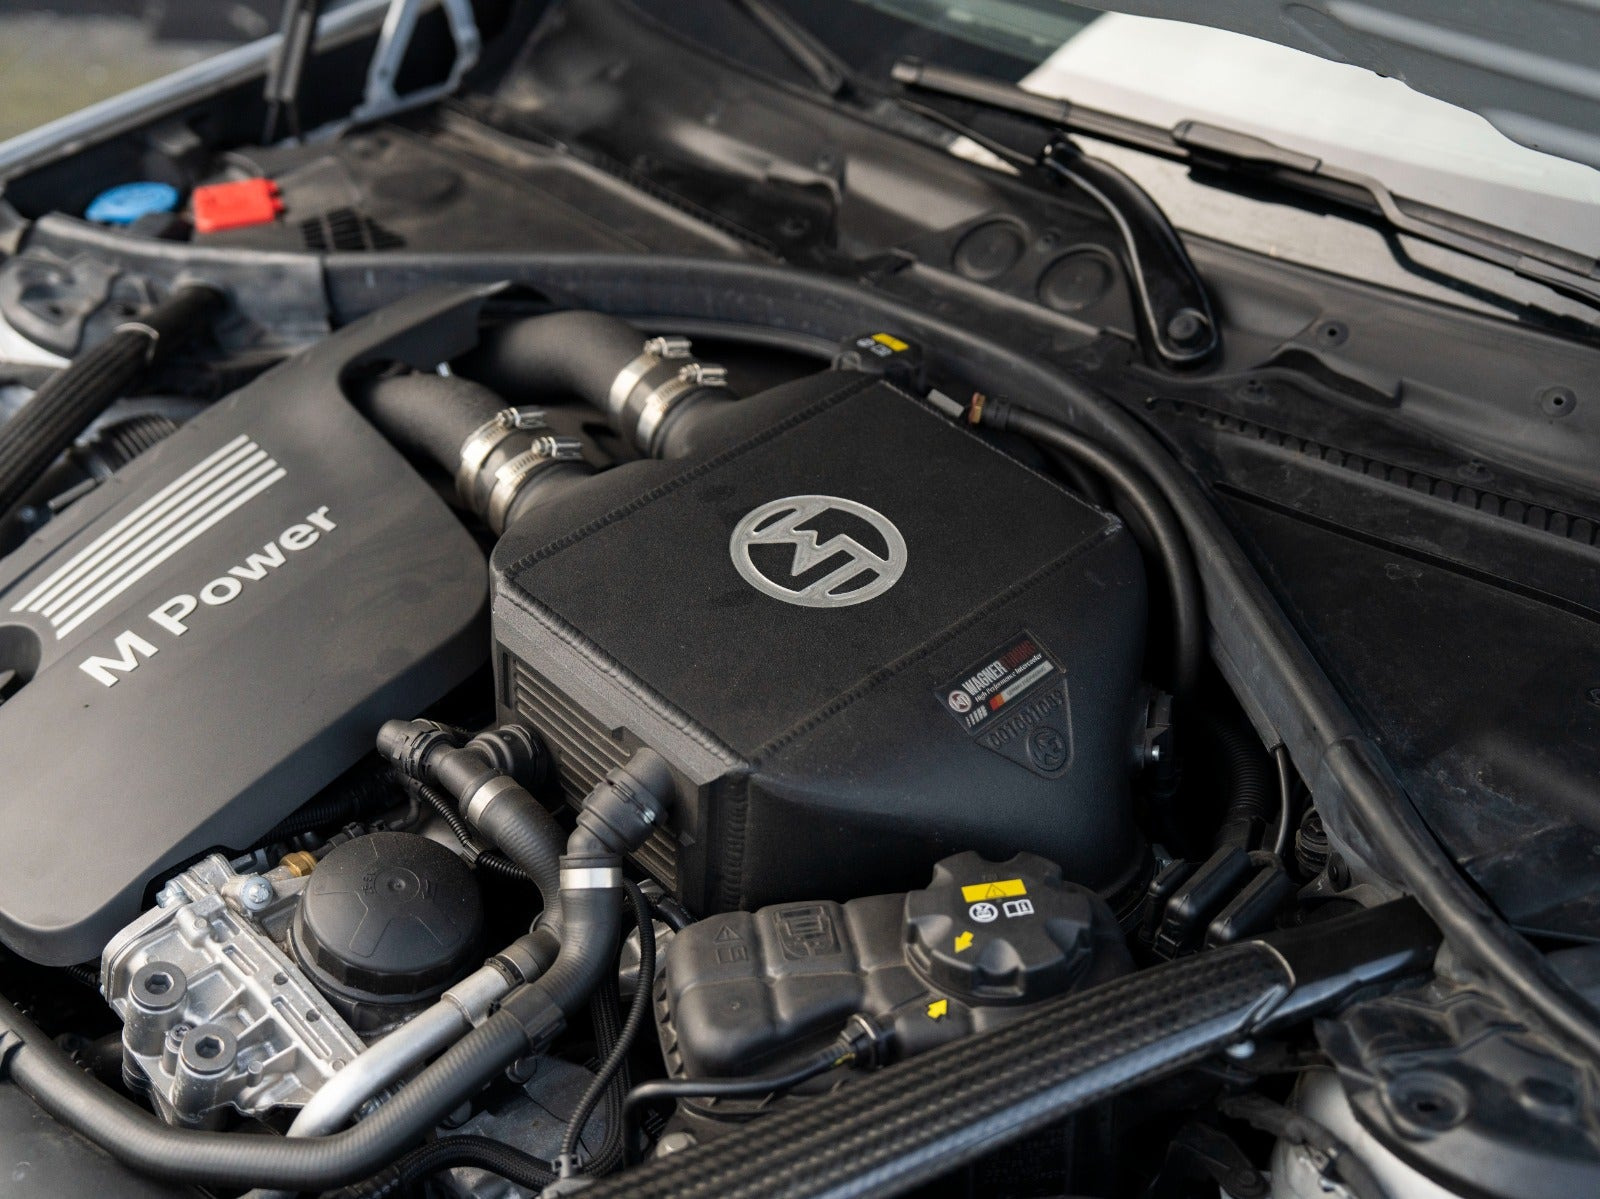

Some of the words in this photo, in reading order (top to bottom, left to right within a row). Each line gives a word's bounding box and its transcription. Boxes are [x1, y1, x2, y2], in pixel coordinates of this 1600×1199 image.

[78, 629, 160, 688] M
[147, 505, 338, 637] Power
[961, 660, 1008, 696] WAGNER
[974, 690, 988, 703] High
[986, 671, 1017, 695] Performance
[1014, 652, 1042, 674] Intercooler
